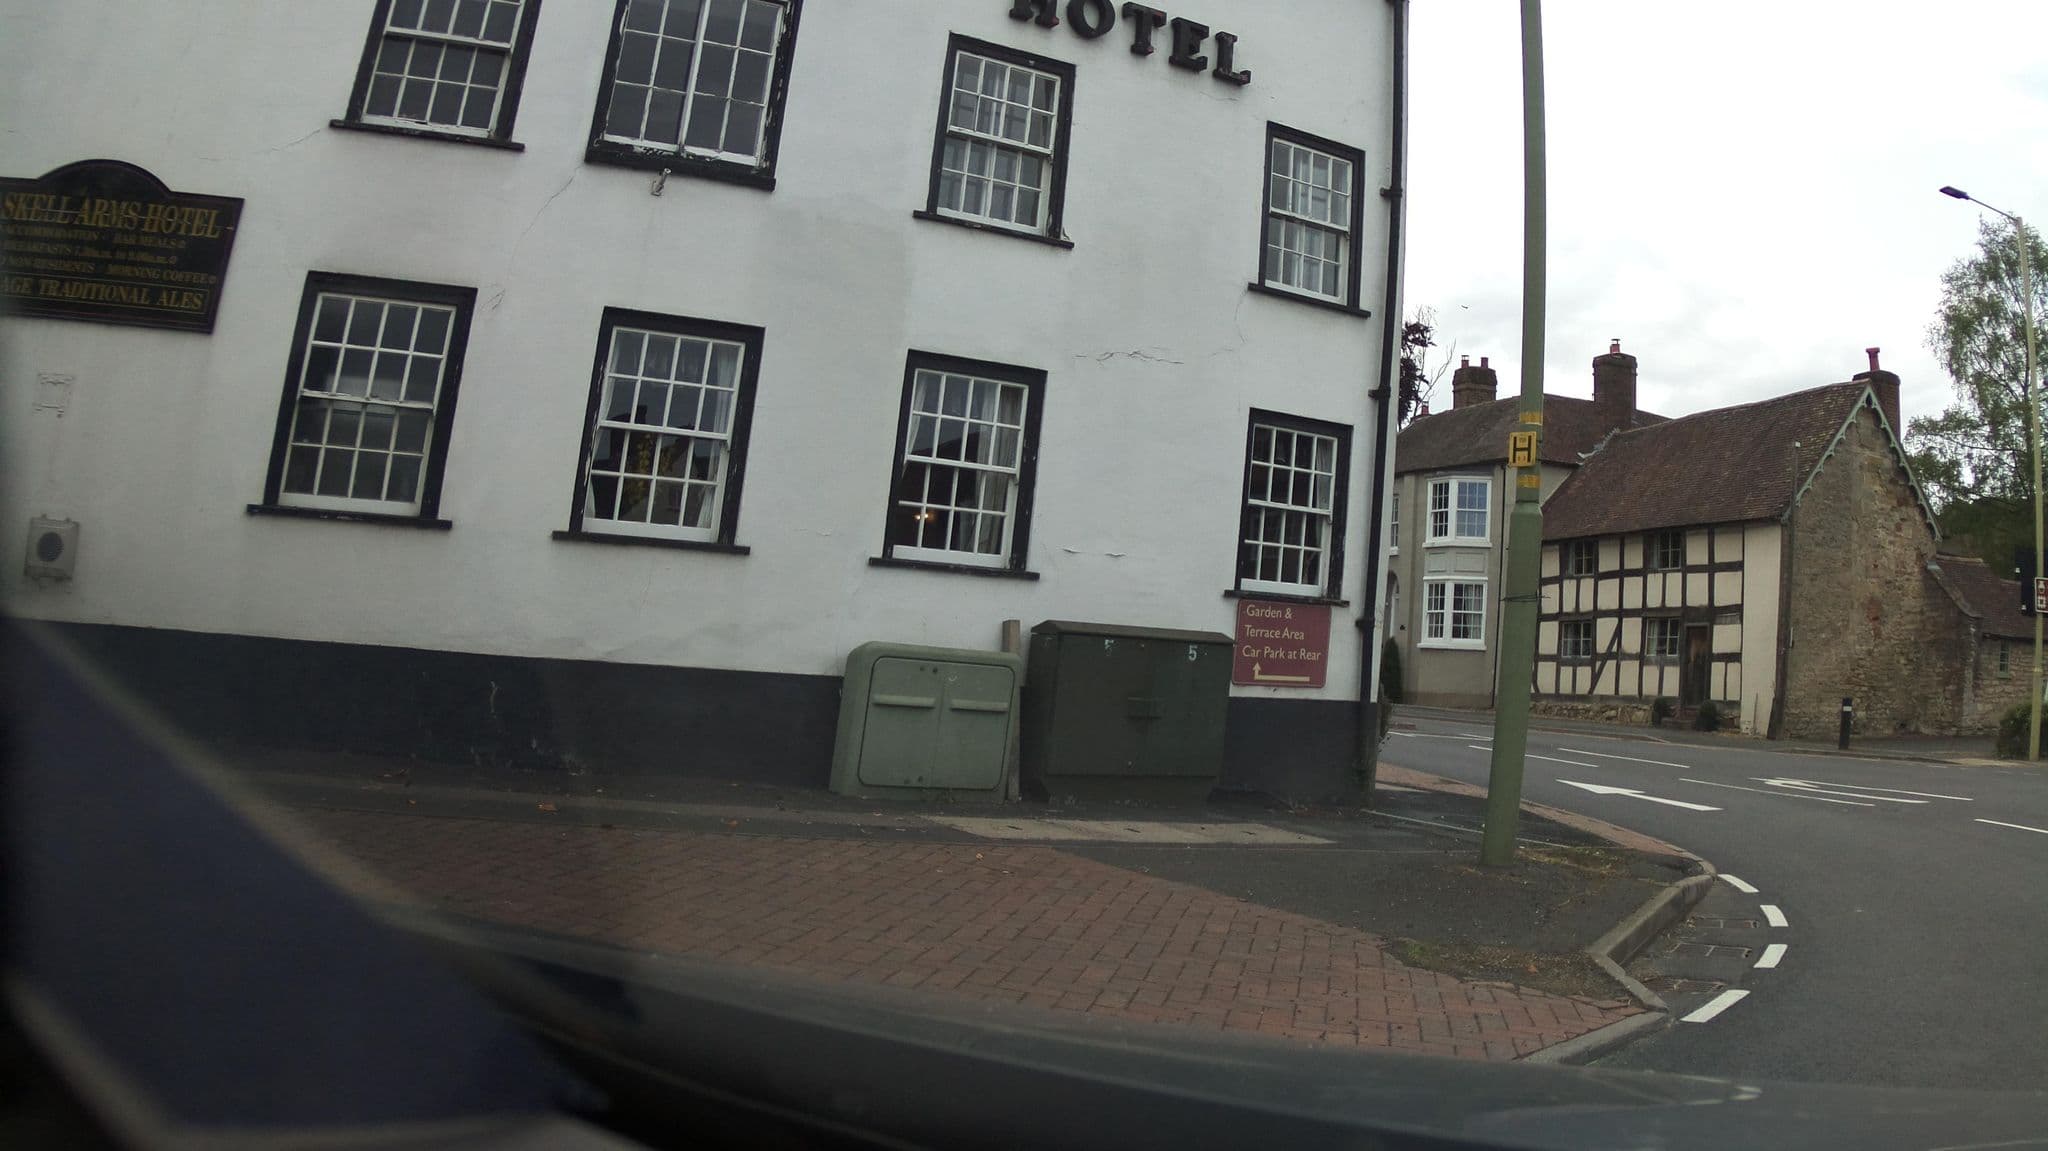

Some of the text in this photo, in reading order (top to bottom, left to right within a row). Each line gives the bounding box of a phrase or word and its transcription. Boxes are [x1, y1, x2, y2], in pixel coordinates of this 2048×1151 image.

[73, 196, 141, 231] ARMS
[142, 203, 221, 239] HOTEL
[163, 269, 208, 285] COFFEE
[40, 279, 152, 306] TRADITIONAL
[155, 290, 204, 311] ALES
[1513, 435, 1532, 463] H
[1246, 604, 1293, 619] Garden &
[1245, 624, 1305, 641] Terrace Area
[1188, 645, 1198, 661] 5
[1242, 645, 1321, 662] Car Park at Rear
